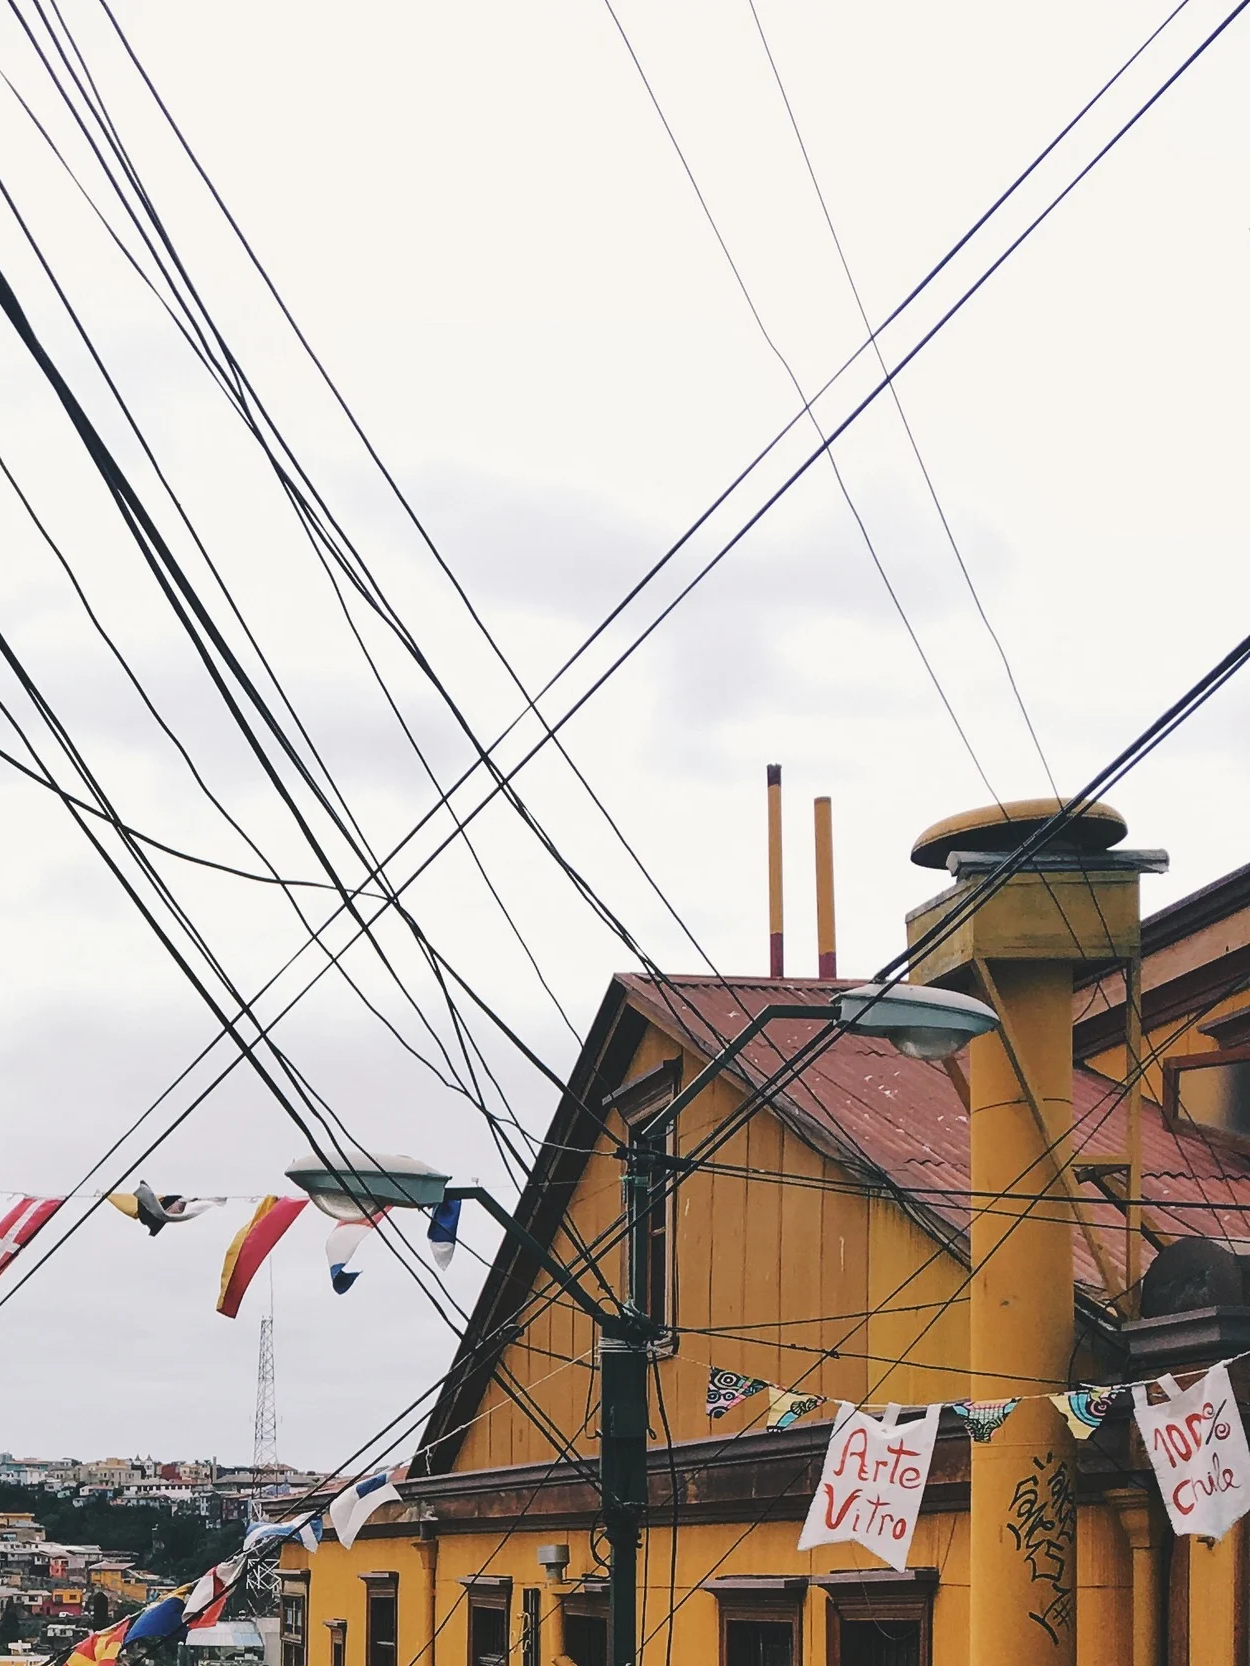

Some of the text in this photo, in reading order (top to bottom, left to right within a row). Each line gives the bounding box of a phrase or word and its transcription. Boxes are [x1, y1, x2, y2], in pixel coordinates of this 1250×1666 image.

[833, 1427, 922, 1490] Arte
[1153, 1398, 1231, 1469] 100%
[822, 1482, 908, 1541] Vitro
[1172, 1451, 1242, 1516] Chile
